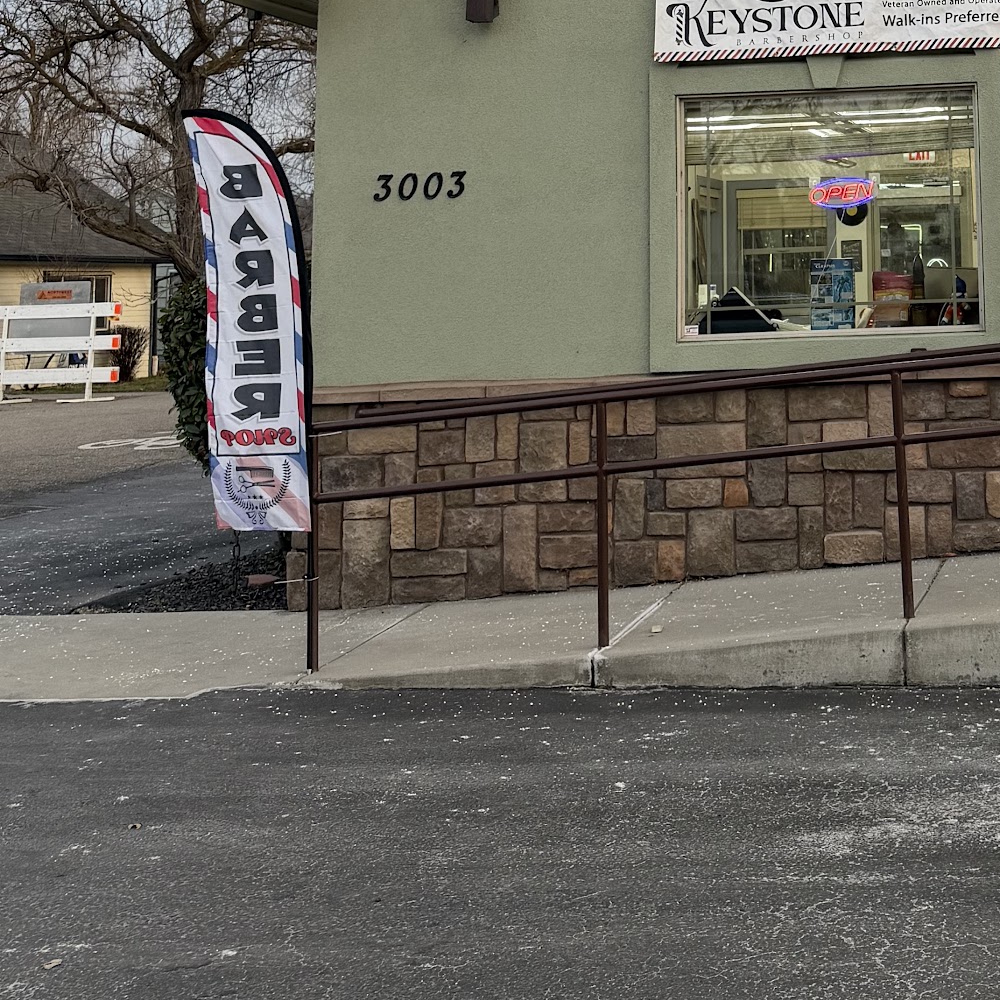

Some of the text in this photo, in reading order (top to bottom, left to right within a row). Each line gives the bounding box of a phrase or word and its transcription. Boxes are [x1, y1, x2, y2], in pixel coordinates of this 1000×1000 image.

[882, 0, 914, 8] Veteran
[917, 0, 947, 7] Owned
[882, 13, 941, 27] Walk-ins
[736, 31, 863, 46] BARBERSHOP
[373, 170, 467, 202] 3003
[808, 181, 875, 205] OPEN
